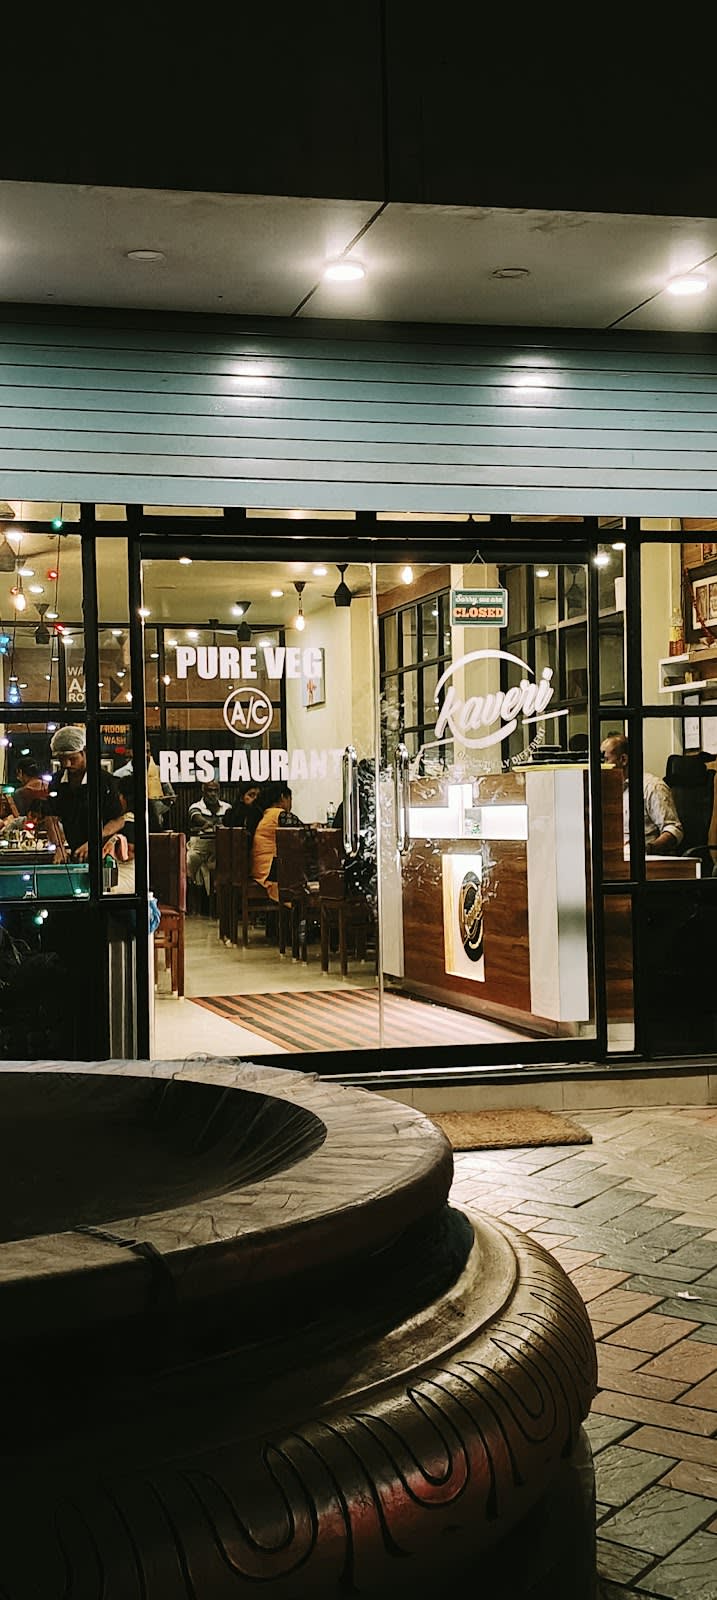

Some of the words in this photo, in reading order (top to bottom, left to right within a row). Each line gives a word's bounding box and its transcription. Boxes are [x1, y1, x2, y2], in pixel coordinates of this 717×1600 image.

[453, 607, 504, 618] CLOSED
[176, 646, 257, 680] PURE
[263, 646, 323, 680] VEG
[69, 693, 85, 703] RO
[231, 696, 268, 729] A/C
[434, 667, 554, 738] kaveri
[511, 727, 545, 764] DIFFERENT
[159, 749, 343, 783] RESTAURANT
